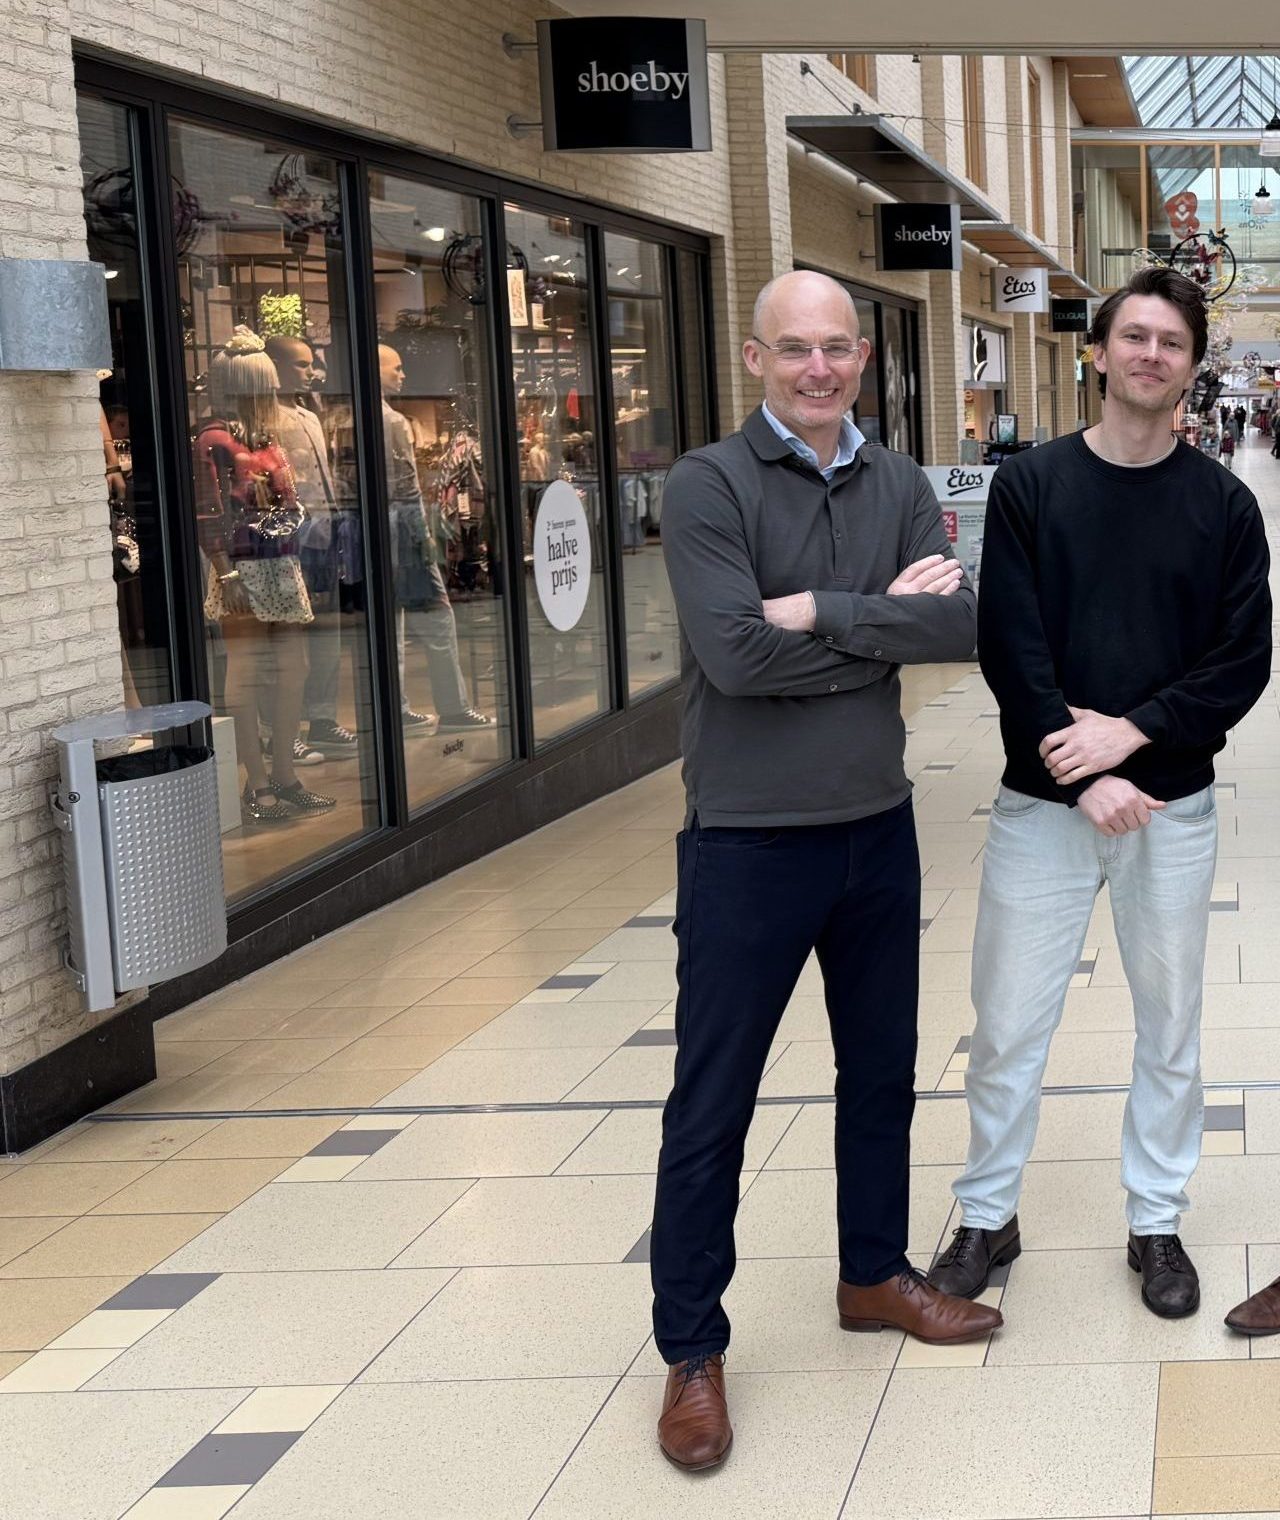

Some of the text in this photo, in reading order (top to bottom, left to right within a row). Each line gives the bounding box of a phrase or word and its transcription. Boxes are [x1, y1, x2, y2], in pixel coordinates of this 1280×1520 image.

[577, 60, 689, 100] shoeby
[894, 224, 952, 246] shoeby
[1002, 275, 1037, 296] Etos
[946, 467, 984, 489] Etos
[546, 532, 579, 562] halve
[551, 560, 578, 596] prijs
